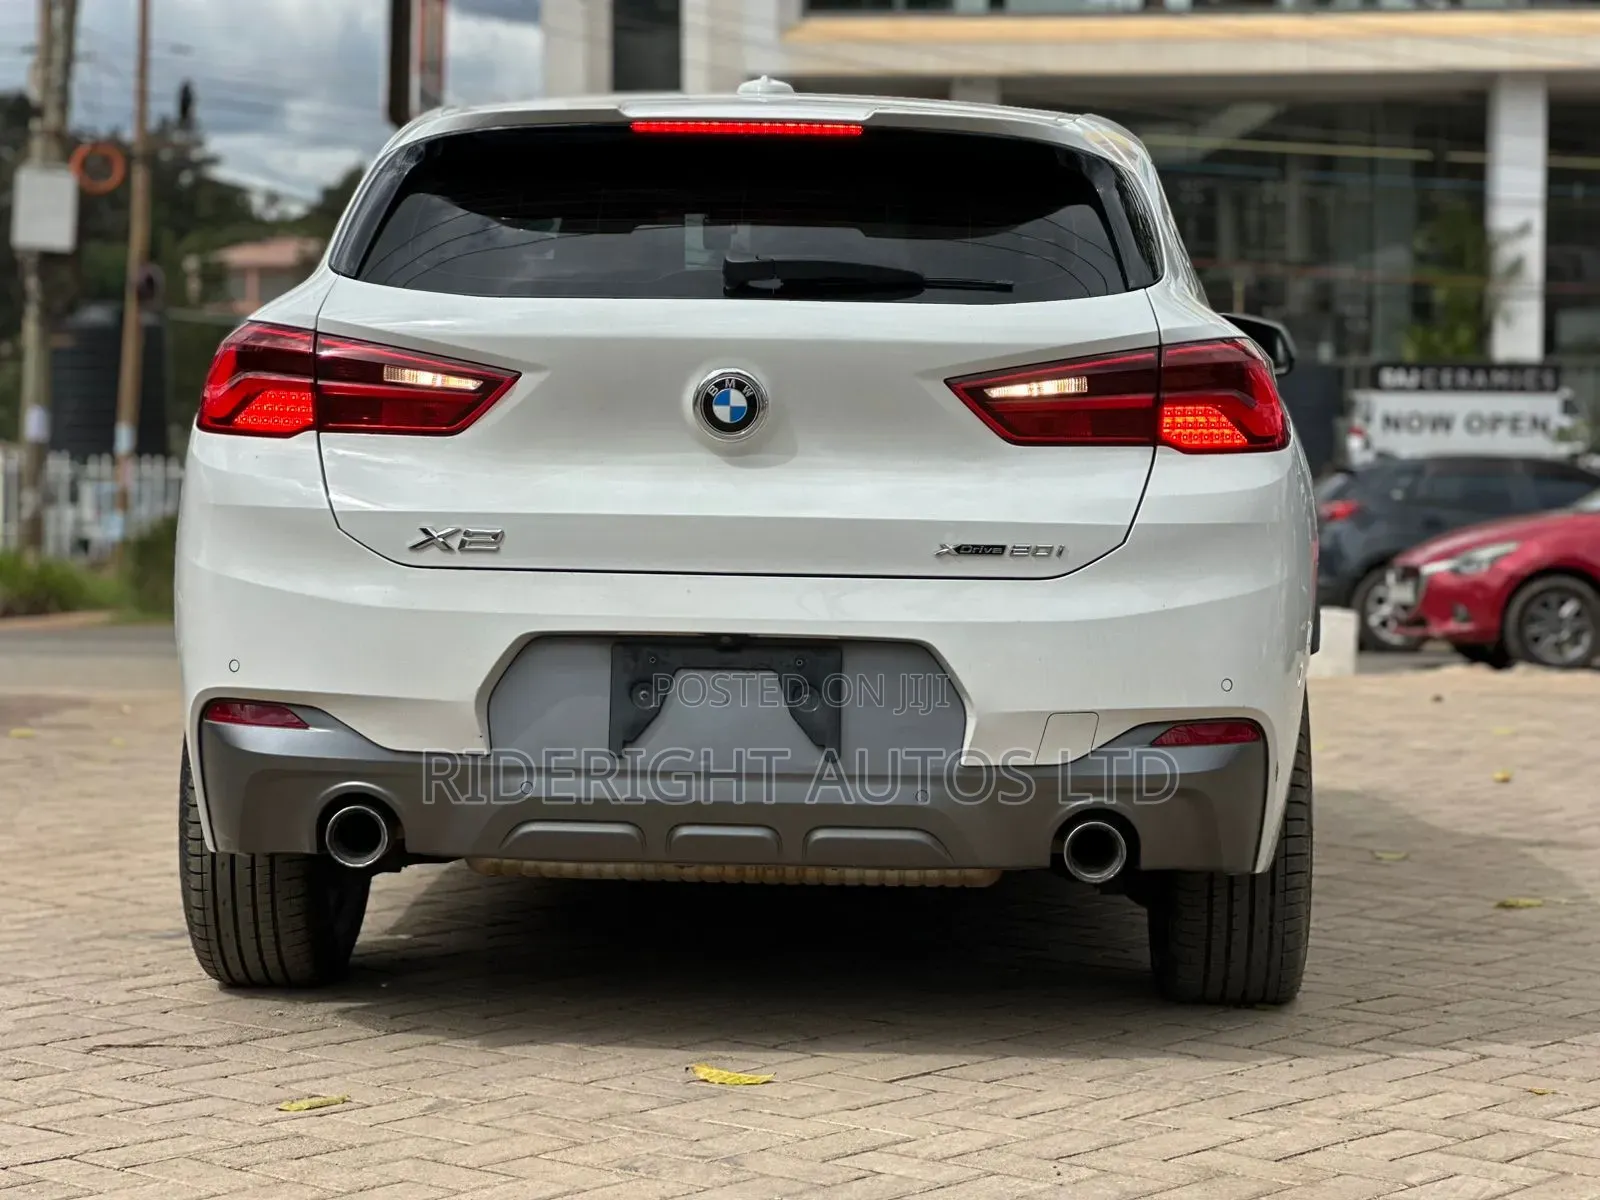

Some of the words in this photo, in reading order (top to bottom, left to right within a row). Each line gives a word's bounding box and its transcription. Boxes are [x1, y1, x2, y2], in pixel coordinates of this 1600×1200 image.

[707, 379, 754, 397] BMW
[1382, 412, 1455, 436] NOW
[1463, 412, 1549, 437] OPEN
[408, 526, 505, 552] X2
